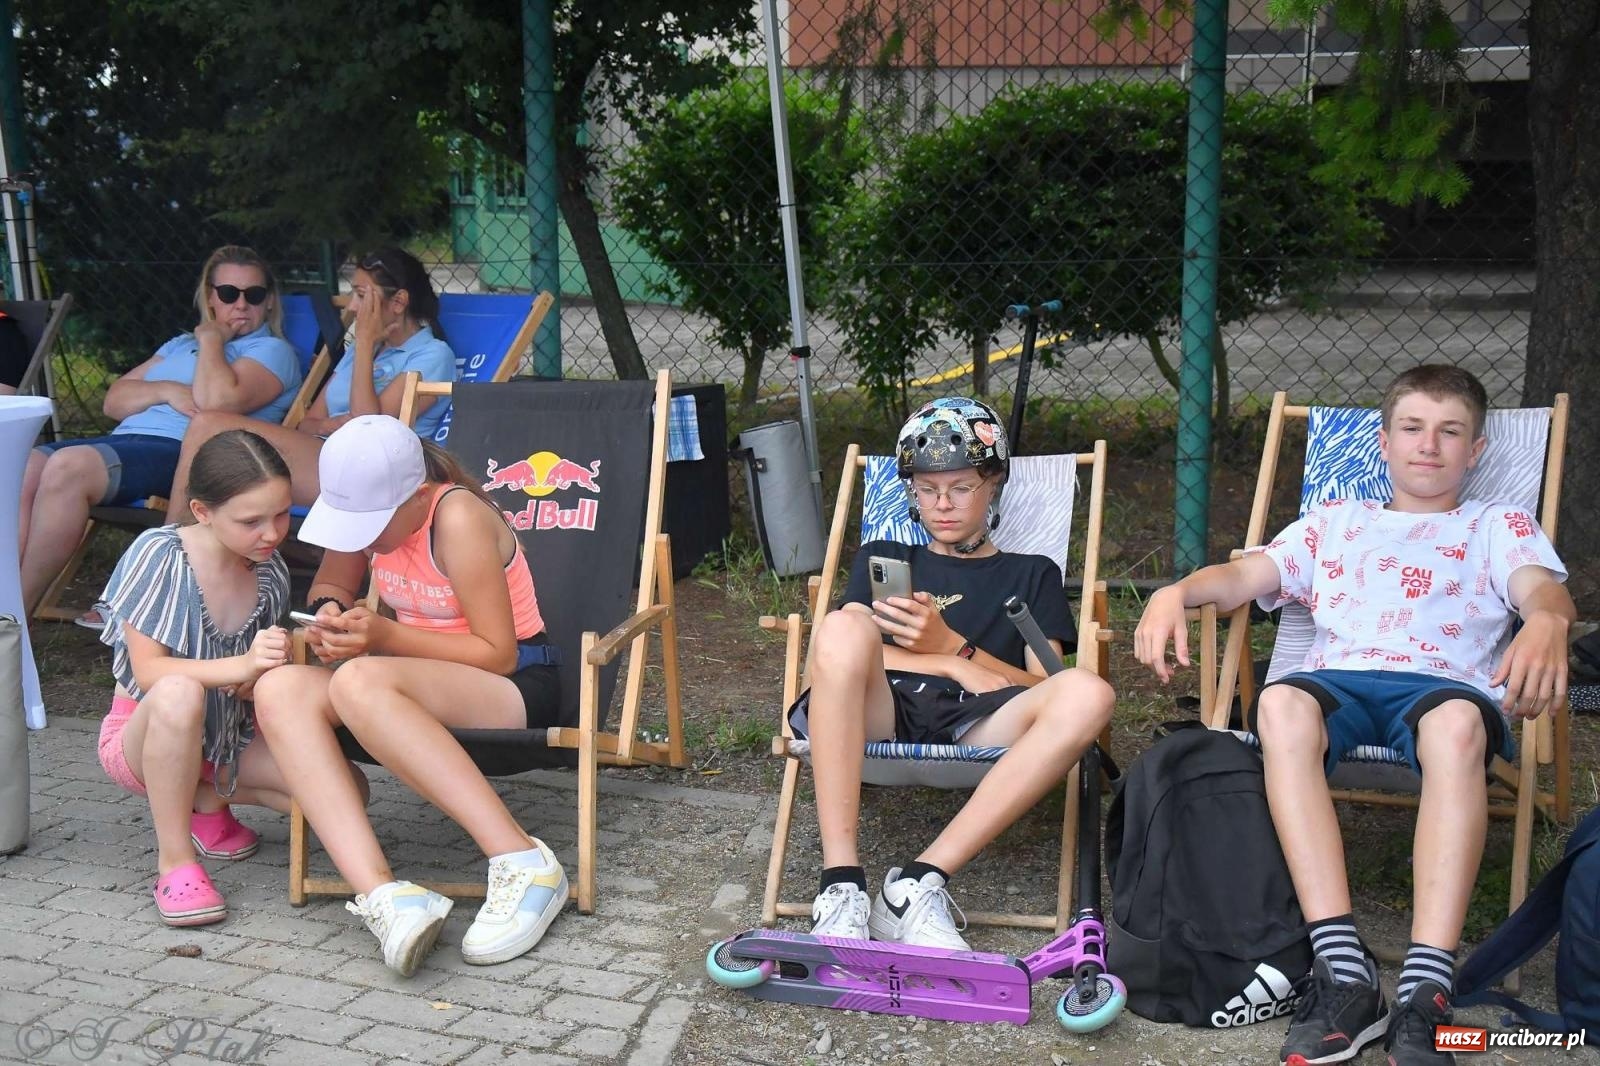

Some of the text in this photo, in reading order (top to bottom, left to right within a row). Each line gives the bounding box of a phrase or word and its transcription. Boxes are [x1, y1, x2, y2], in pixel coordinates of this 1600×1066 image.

[536, 498, 599, 532] Bull
[1401, 566, 1433, 580] CALI
[410, 580, 455, 599] VIBES
